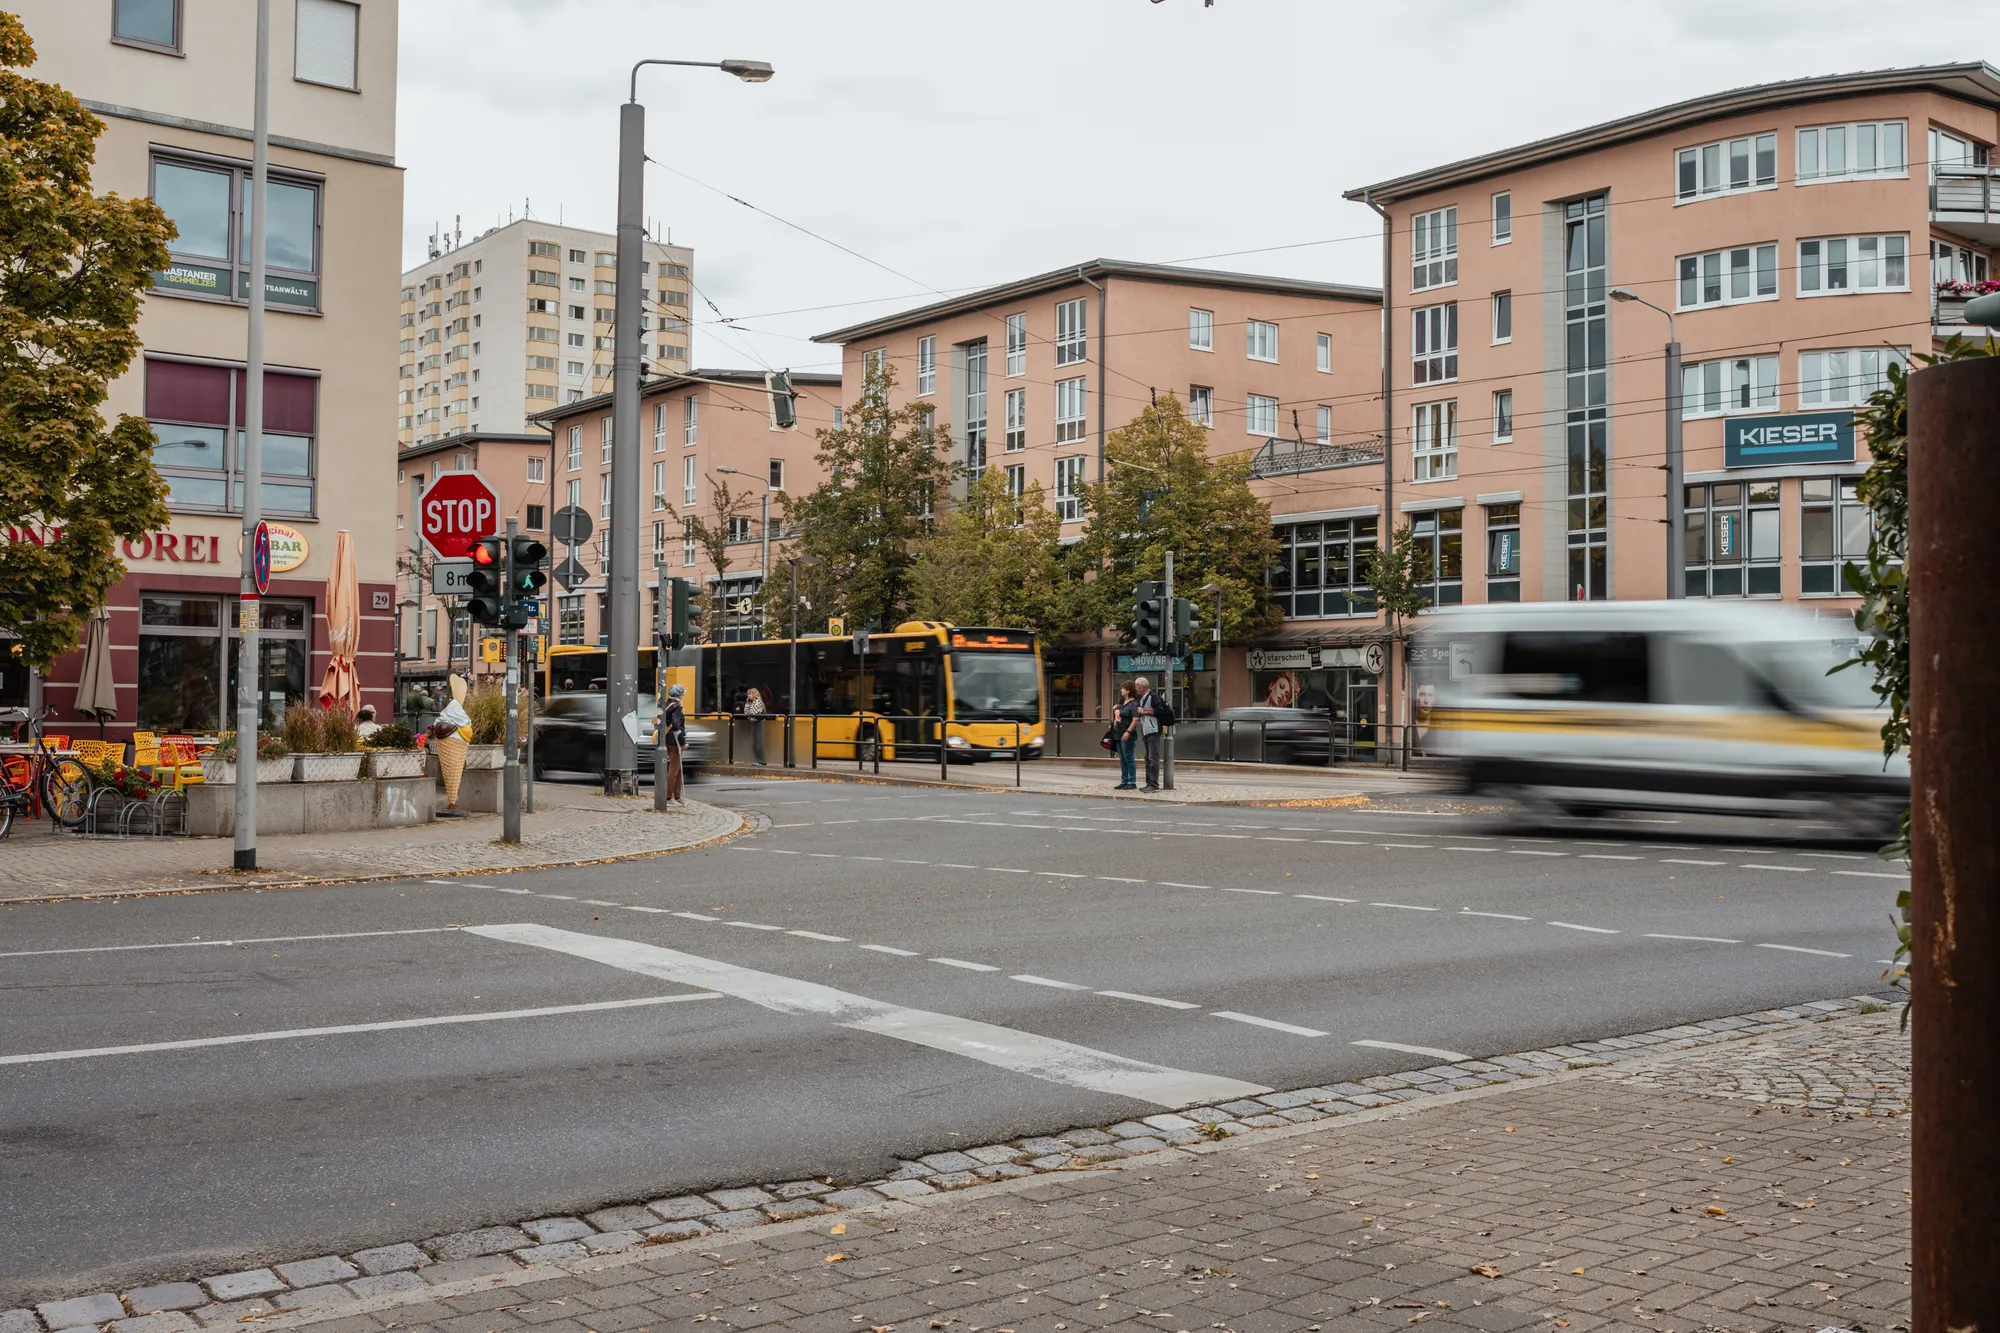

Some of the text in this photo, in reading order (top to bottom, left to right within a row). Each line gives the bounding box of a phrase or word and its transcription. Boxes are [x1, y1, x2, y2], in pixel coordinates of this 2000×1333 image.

[170, 276, 216, 288] SCHMELZER
[246, 282, 308, 296] RTSANWÄLTE
[1740, 423, 1838, 445] KIESER
[427, 498, 491, 534] STOP
[268, 526, 294, 539] ginal
[1720, 515, 1729, 555] KIESER
[271, 540, 302, 552] BAR
[1500, 534, 1508, 569] KIESER
[446, 571, 454, 586] 8
[375, 595, 388, 605] 29
[1130, 656, 1180, 665] SNOW NALS
[1267, 653, 1305, 661] starschnitt
